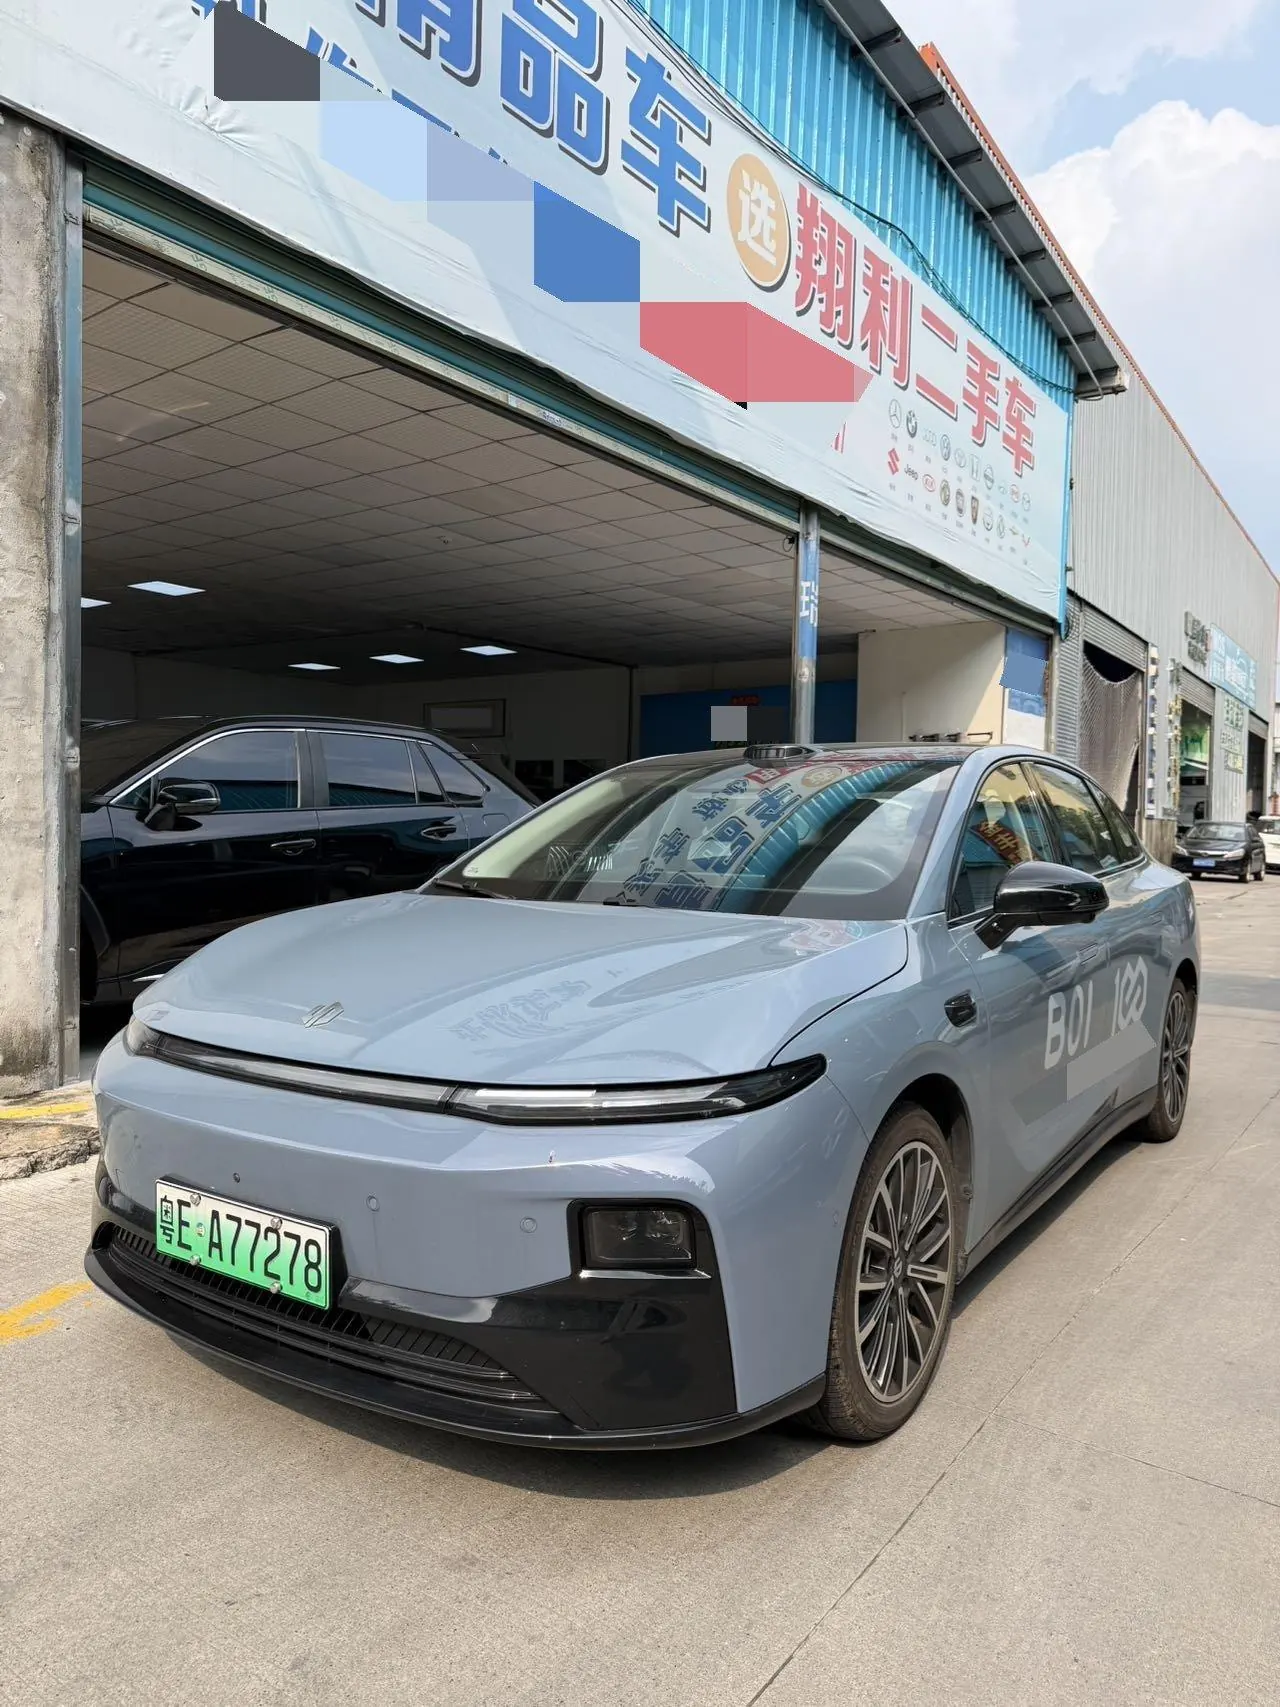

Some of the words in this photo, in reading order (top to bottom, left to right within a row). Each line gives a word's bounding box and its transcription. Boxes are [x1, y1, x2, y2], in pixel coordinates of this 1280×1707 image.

[793, 181, 1037, 477] 翔利二手车
